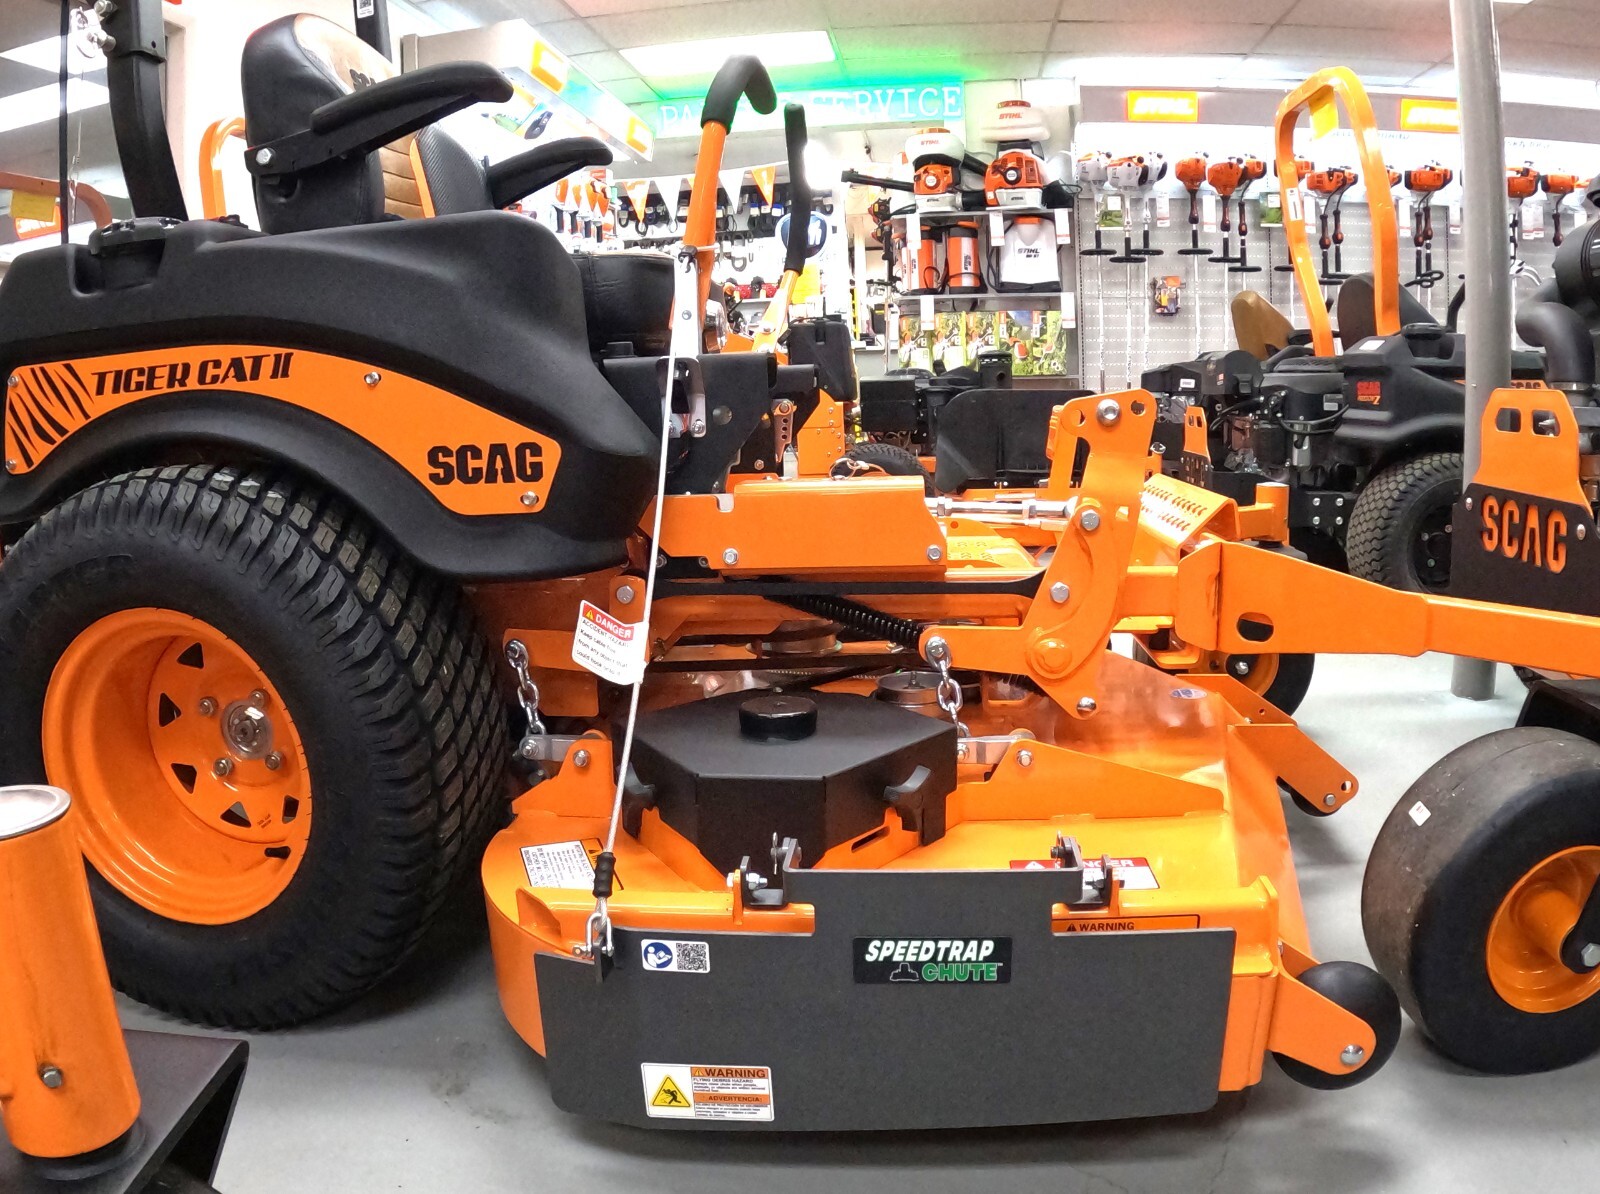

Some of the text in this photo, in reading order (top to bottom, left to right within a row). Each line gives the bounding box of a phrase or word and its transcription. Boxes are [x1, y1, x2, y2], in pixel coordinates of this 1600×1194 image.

[91, 352, 294, 396] TIGER CAT II
[427, 441, 544, 485] SCAG
[1481, 495, 1568, 574] SCAG
[595, 613, 632, 639] DANGER
[1079, 921, 1135, 932] WARNING
[865, 939, 995, 962] SPEEDTRAP
[921, 962, 998, 982] CHUTE
[704, 1068, 766, 1079] WARNING
